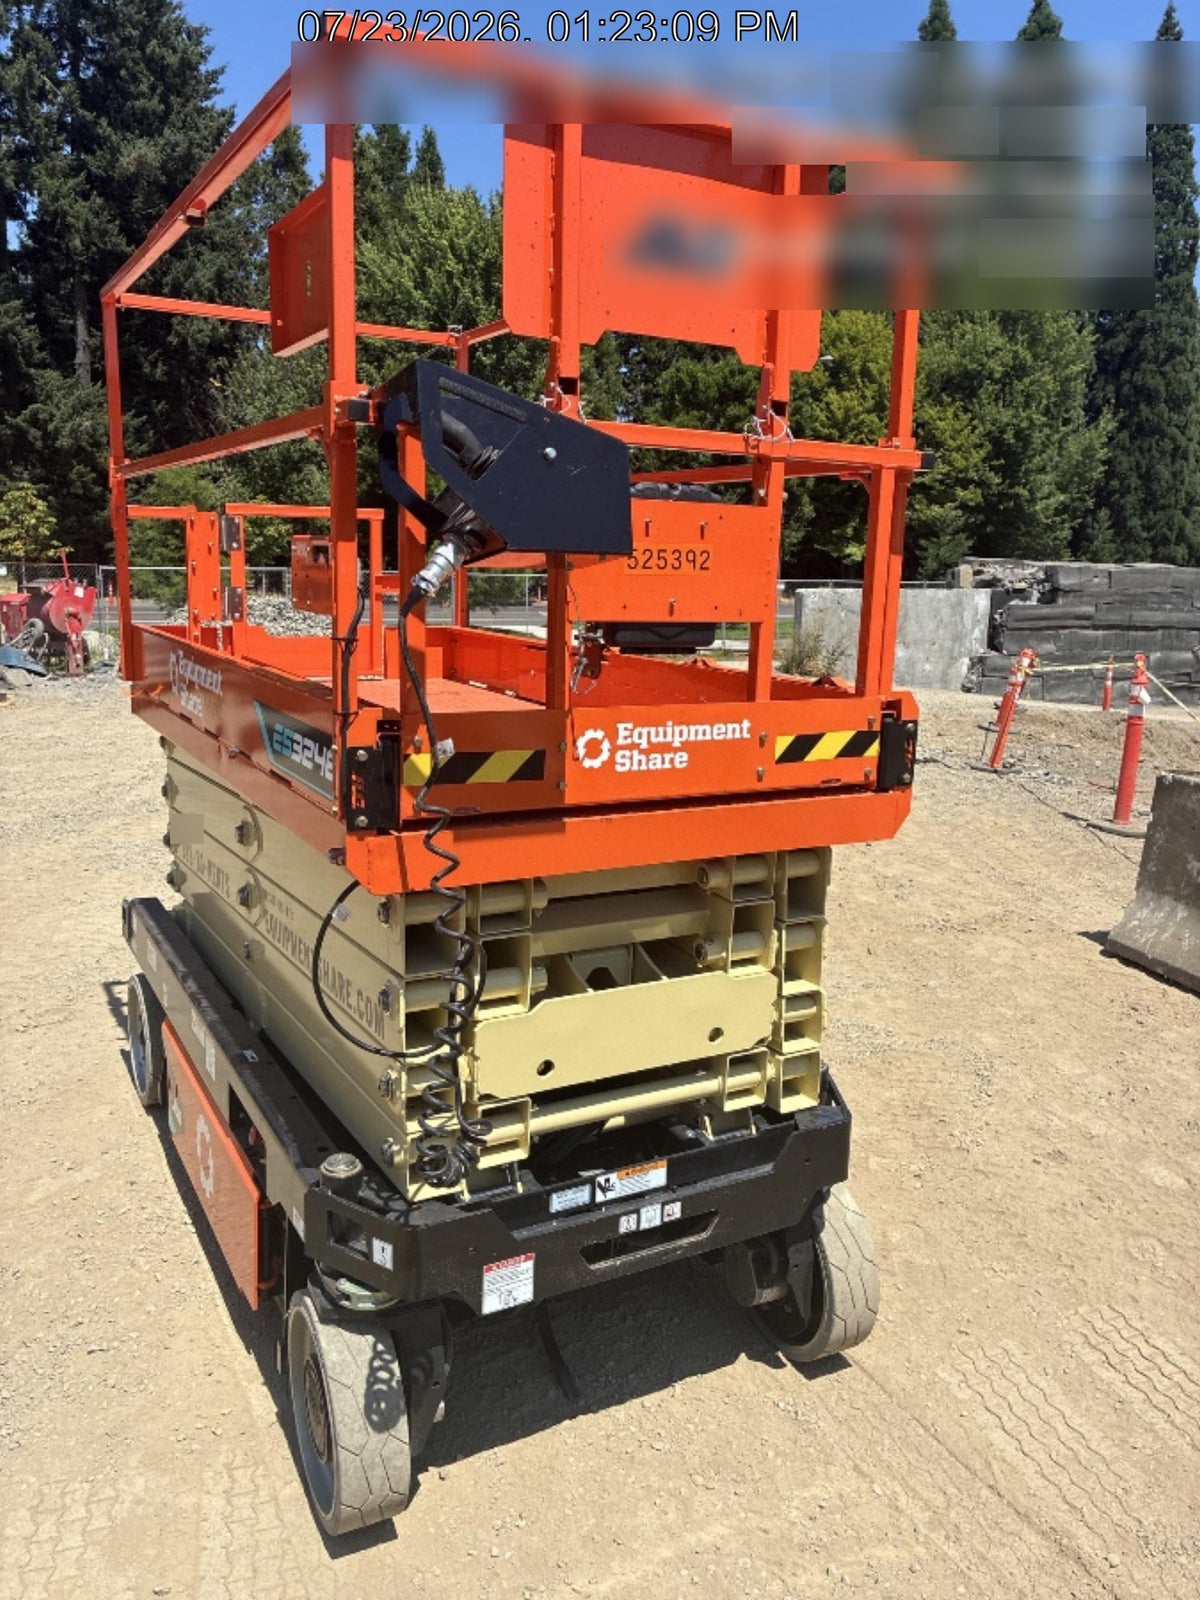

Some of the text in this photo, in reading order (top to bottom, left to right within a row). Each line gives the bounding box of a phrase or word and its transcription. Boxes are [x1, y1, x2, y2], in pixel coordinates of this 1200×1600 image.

[627, 548, 710, 571] 525392
[616, 719, 751, 749] Equipment
[615, 750, 689, 772] Share
